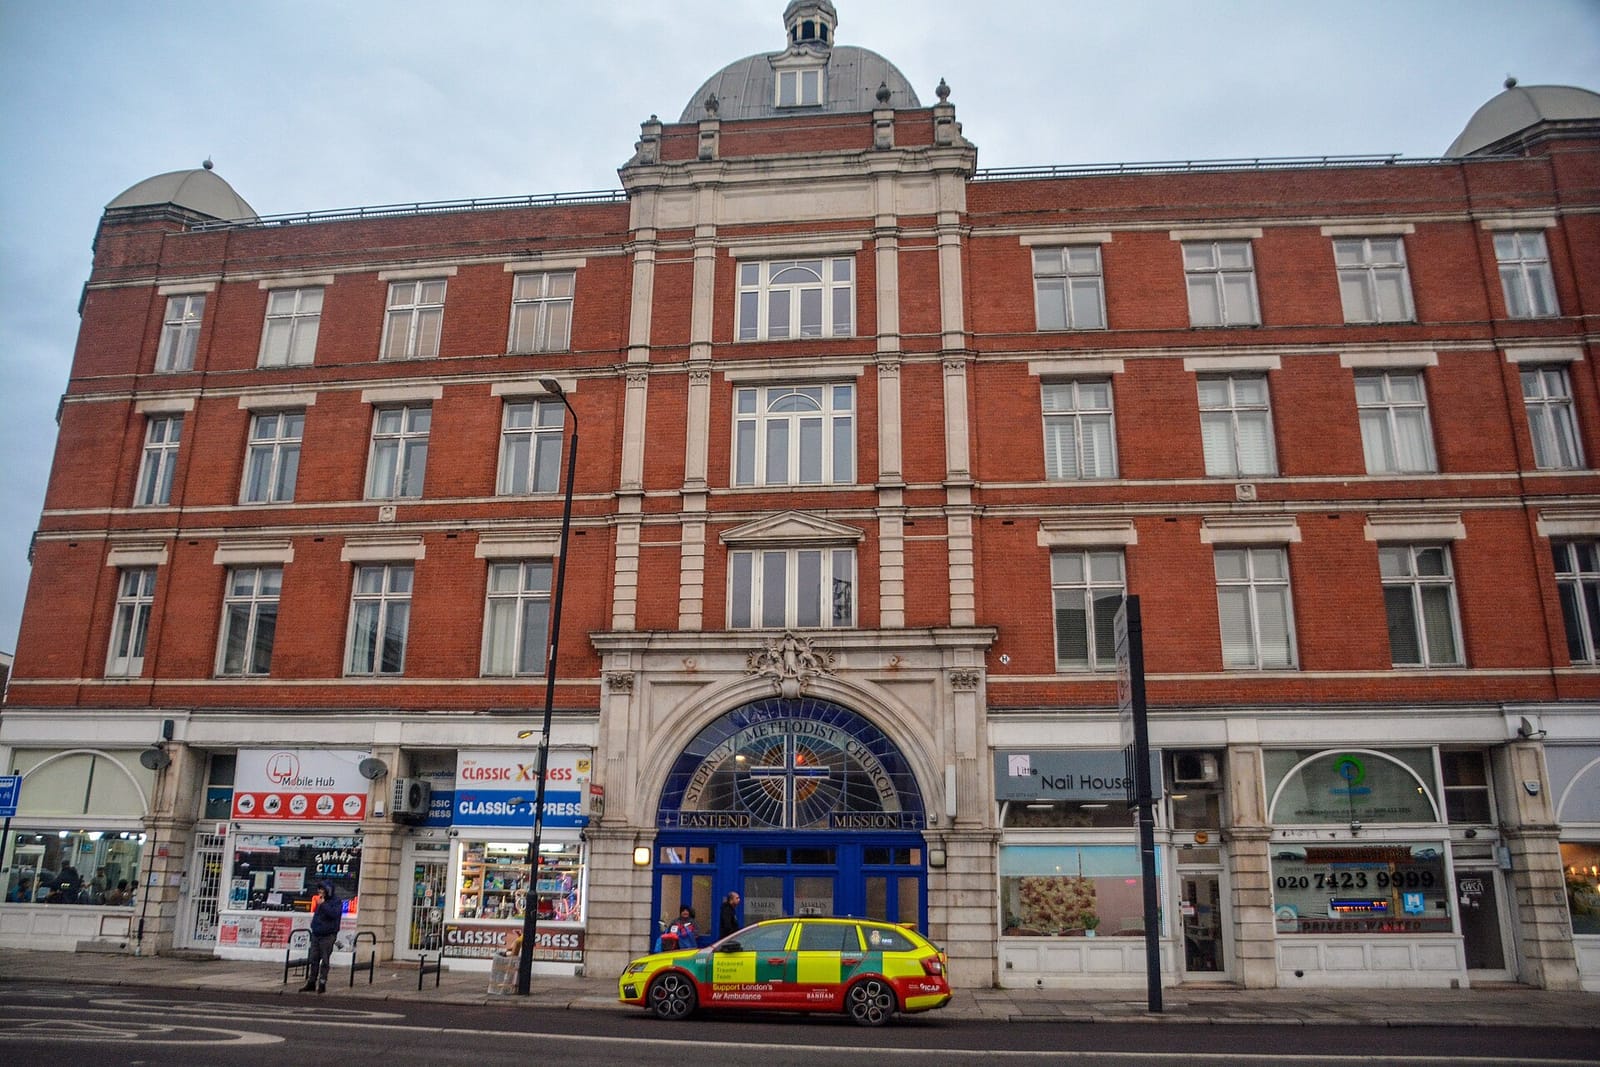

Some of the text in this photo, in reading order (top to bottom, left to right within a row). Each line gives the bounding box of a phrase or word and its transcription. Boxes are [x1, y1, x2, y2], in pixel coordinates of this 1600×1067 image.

[687, 721, 893, 803] STEPNEY METHODIST CHURCH
[462, 768, 510, 781] CLASSIC
[1016, 766, 1038, 777] Little
[282, 777, 335, 787] Mobile Hub
[1041, 774, 1132, 790] Nail House
[459, 801, 515, 816] CLASSIC
[834, 814, 897, 827] MISSION
[314, 851, 352, 863] SMART
[316, 863, 349, 873] CYCLE
[1277, 871, 1435, 889] 020 7423 9999
[1302, 921, 1359, 931] DRIVERS
[447, 930, 507, 946] CLASSIC
[713, 983, 773, 992] Support London's
[723, 992, 762, 1000] Ambulance
